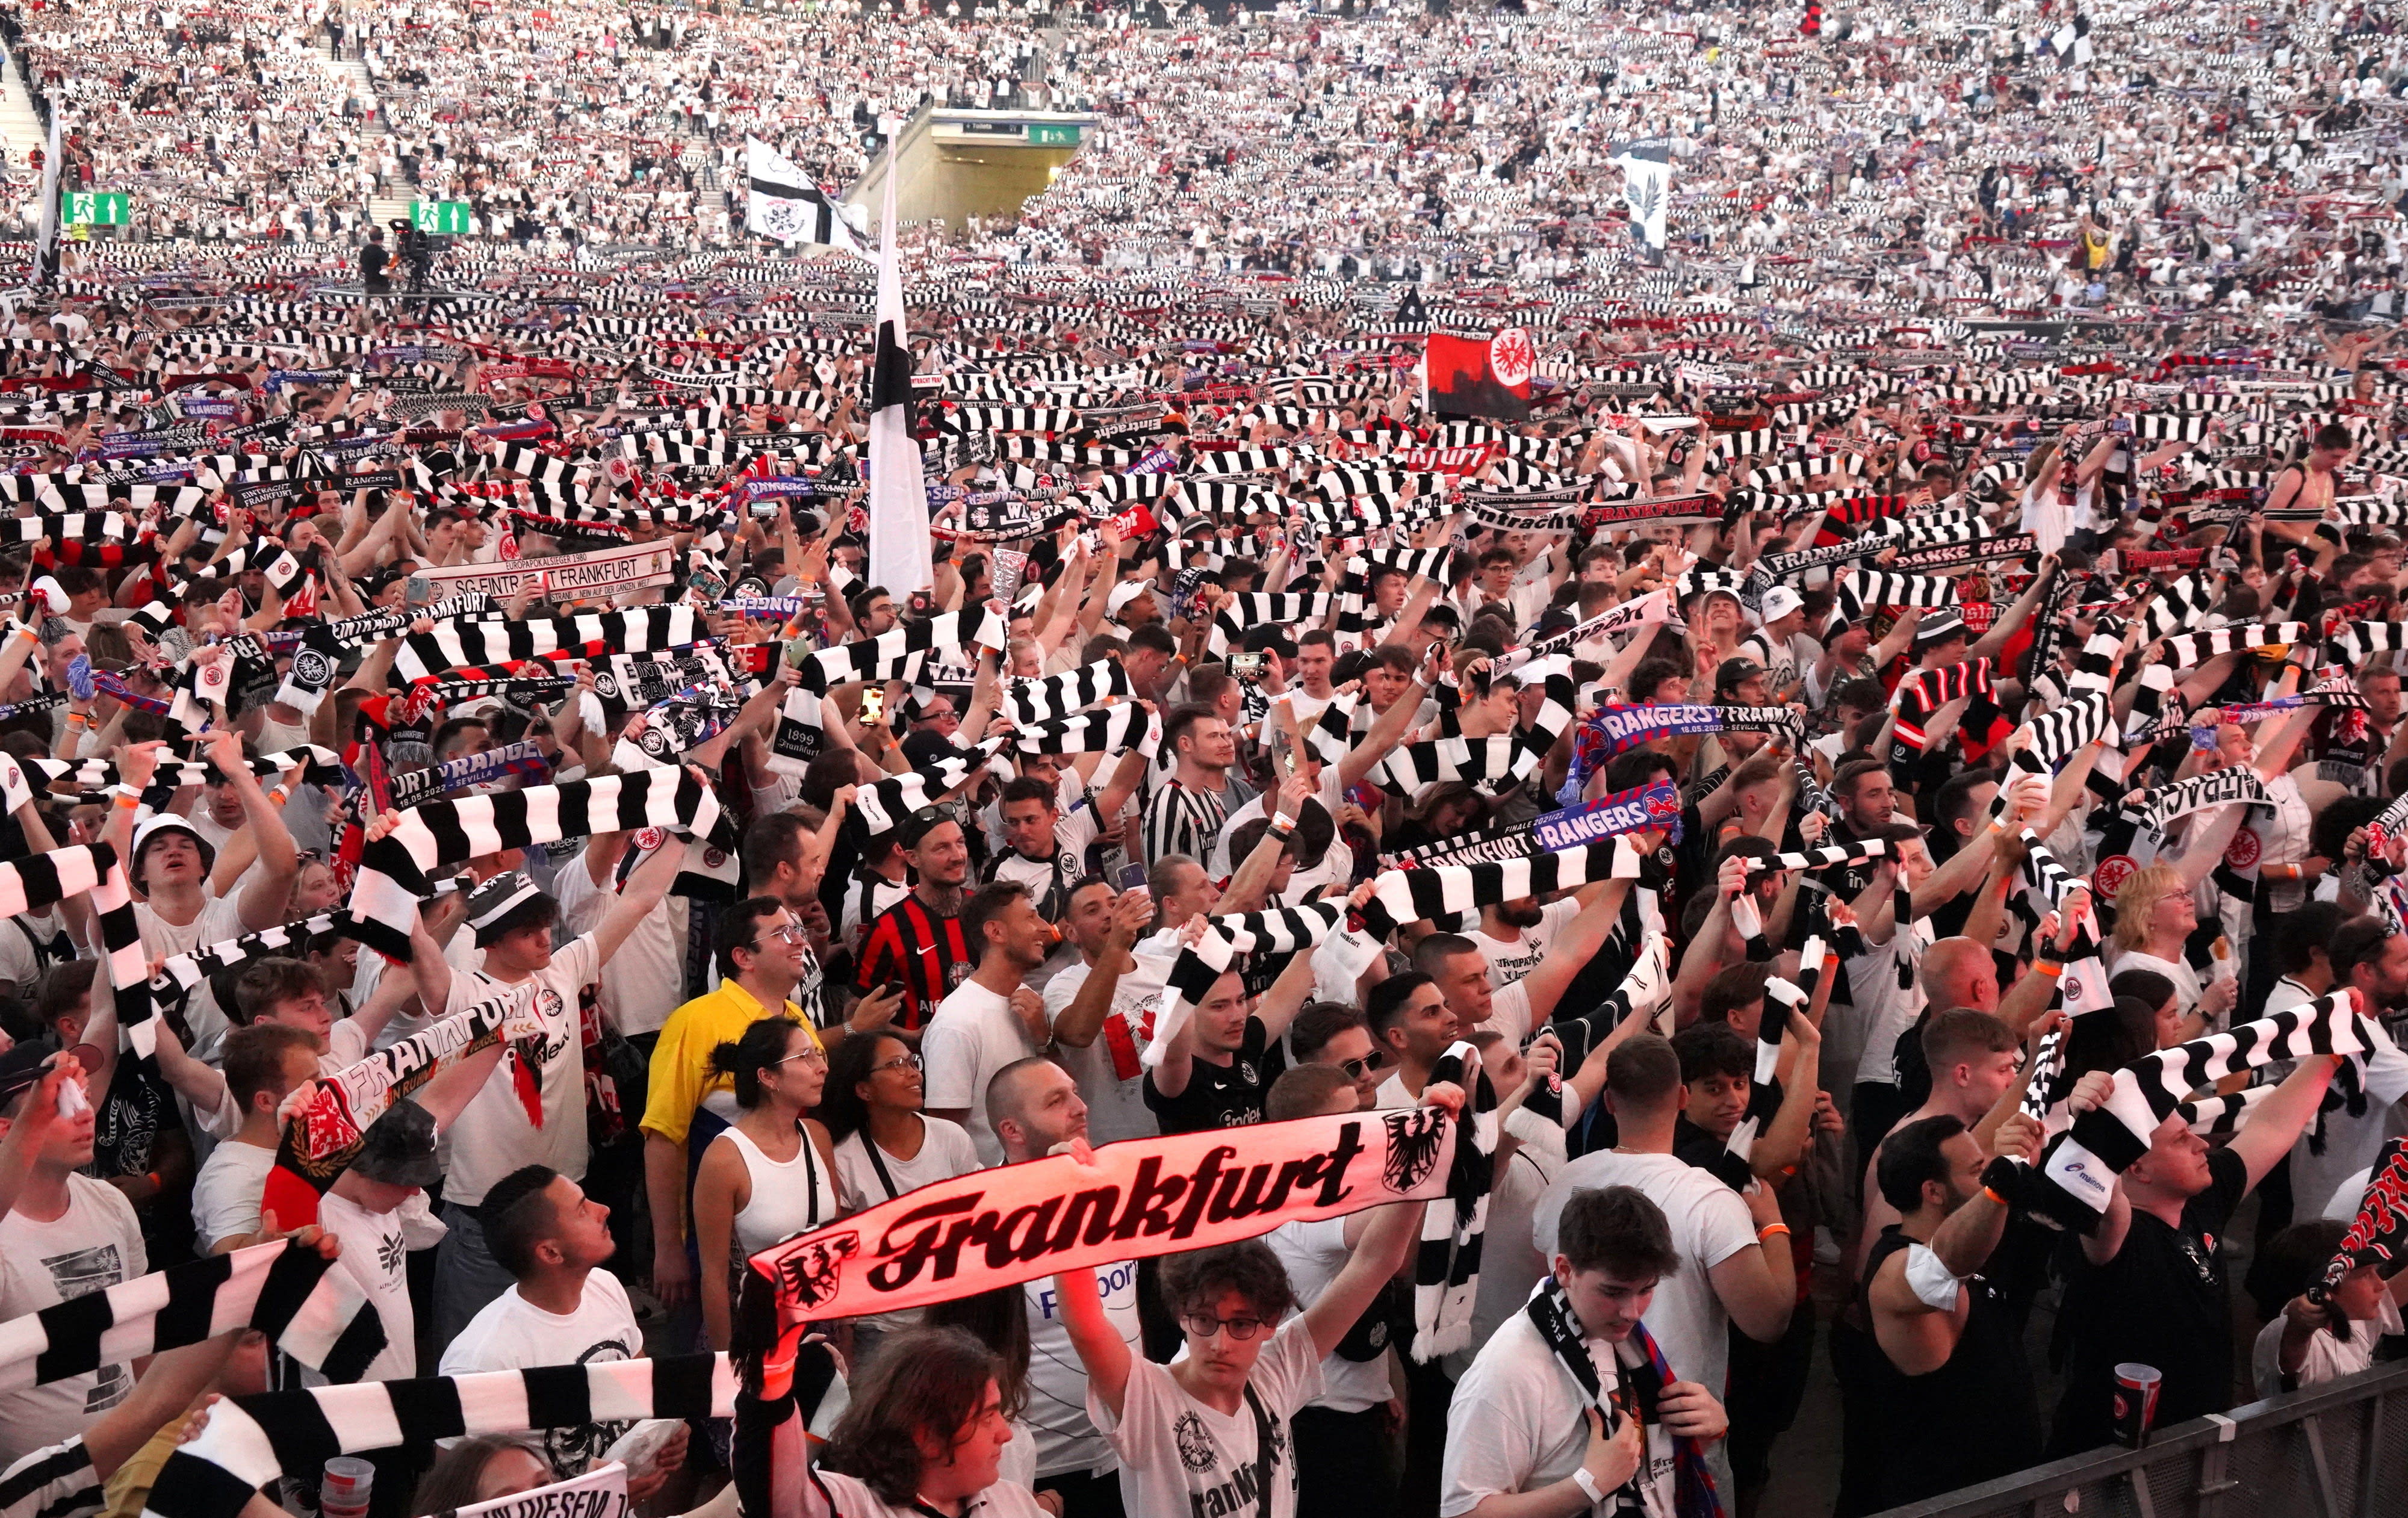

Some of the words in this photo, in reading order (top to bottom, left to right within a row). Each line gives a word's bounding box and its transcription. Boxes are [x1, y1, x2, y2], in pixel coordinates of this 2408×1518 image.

[189, 404, 235, 415] RANGERS
[1093, 417, 1162, 439] Eintracht
[92, 468, 138, 485] NKFURT
[147, 462, 197, 477] RANGE
[345, 476, 395, 486] RANGERS
[241, 483, 290, 498] EINTRACHT
[244, 489, 293, 507] FRANKFURT
[966, 491, 1022, 505] RANGER
[1591, 500, 1704, 522] FRANKFURT
[506, 557, 571, 570] EUROPAPOKALSIEGER
[573, 553, 587, 562] 1980
[1770, 533, 1897, 572] FRANKFURT
[1894, 544, 1970, 569] DANKE
[1979, 536, 2032, 555] PAPA
[456, 580, 477, 595] SG
[479, 571, 557, 595] EINTRT
[560, 559, 638, 588] FRANKFURT
[552, 590, 573, 602] STRAND
[579, 589, 591, 598] NEIN
[592, 587, 603, 596] AUF
[604, 586, 615, 595] DER
[616, 582, 635, 592] GANZEN
[637, 578, 650, 589] WELT
[412, 592, 489, 624] FRANKFURT
[332, 615, 406, 640] EINTRACHT
[622, 654, 710, 680] EINTRACHT
[19, 696, 51, 708] FINALE
[1603, 705, 1714, 741] RANGERS
[1681, 724, 1724, 734] 18.05.2022
[1731, 723, 1760, 732] SEVILLA
[394, 731, 425, 740] FRANKFURT
[778, 737, 820, 757] Frankfurt
[787, 728, 815, 746] 1899
[449, 739, 542, 779] RANGE
[400, 784, 447, 808] 18.05.2022
[456, 770, 492, 787] SEVILLA
[1505, 821, 1531, 834] FINALE
[1533, 811, 1565, 826] 2021/22
[1423, 834, 1528, 869] FRANKFURT
[1542, 801, 1648, 848] RANGERS
[383, 1087, 400, 1108] EIN
[402, 1070, 433, 1096] RUHM
[2079, 1171, 2106, 1194] mainova
[867, 1122, 1365, 1293] Frankfurt
